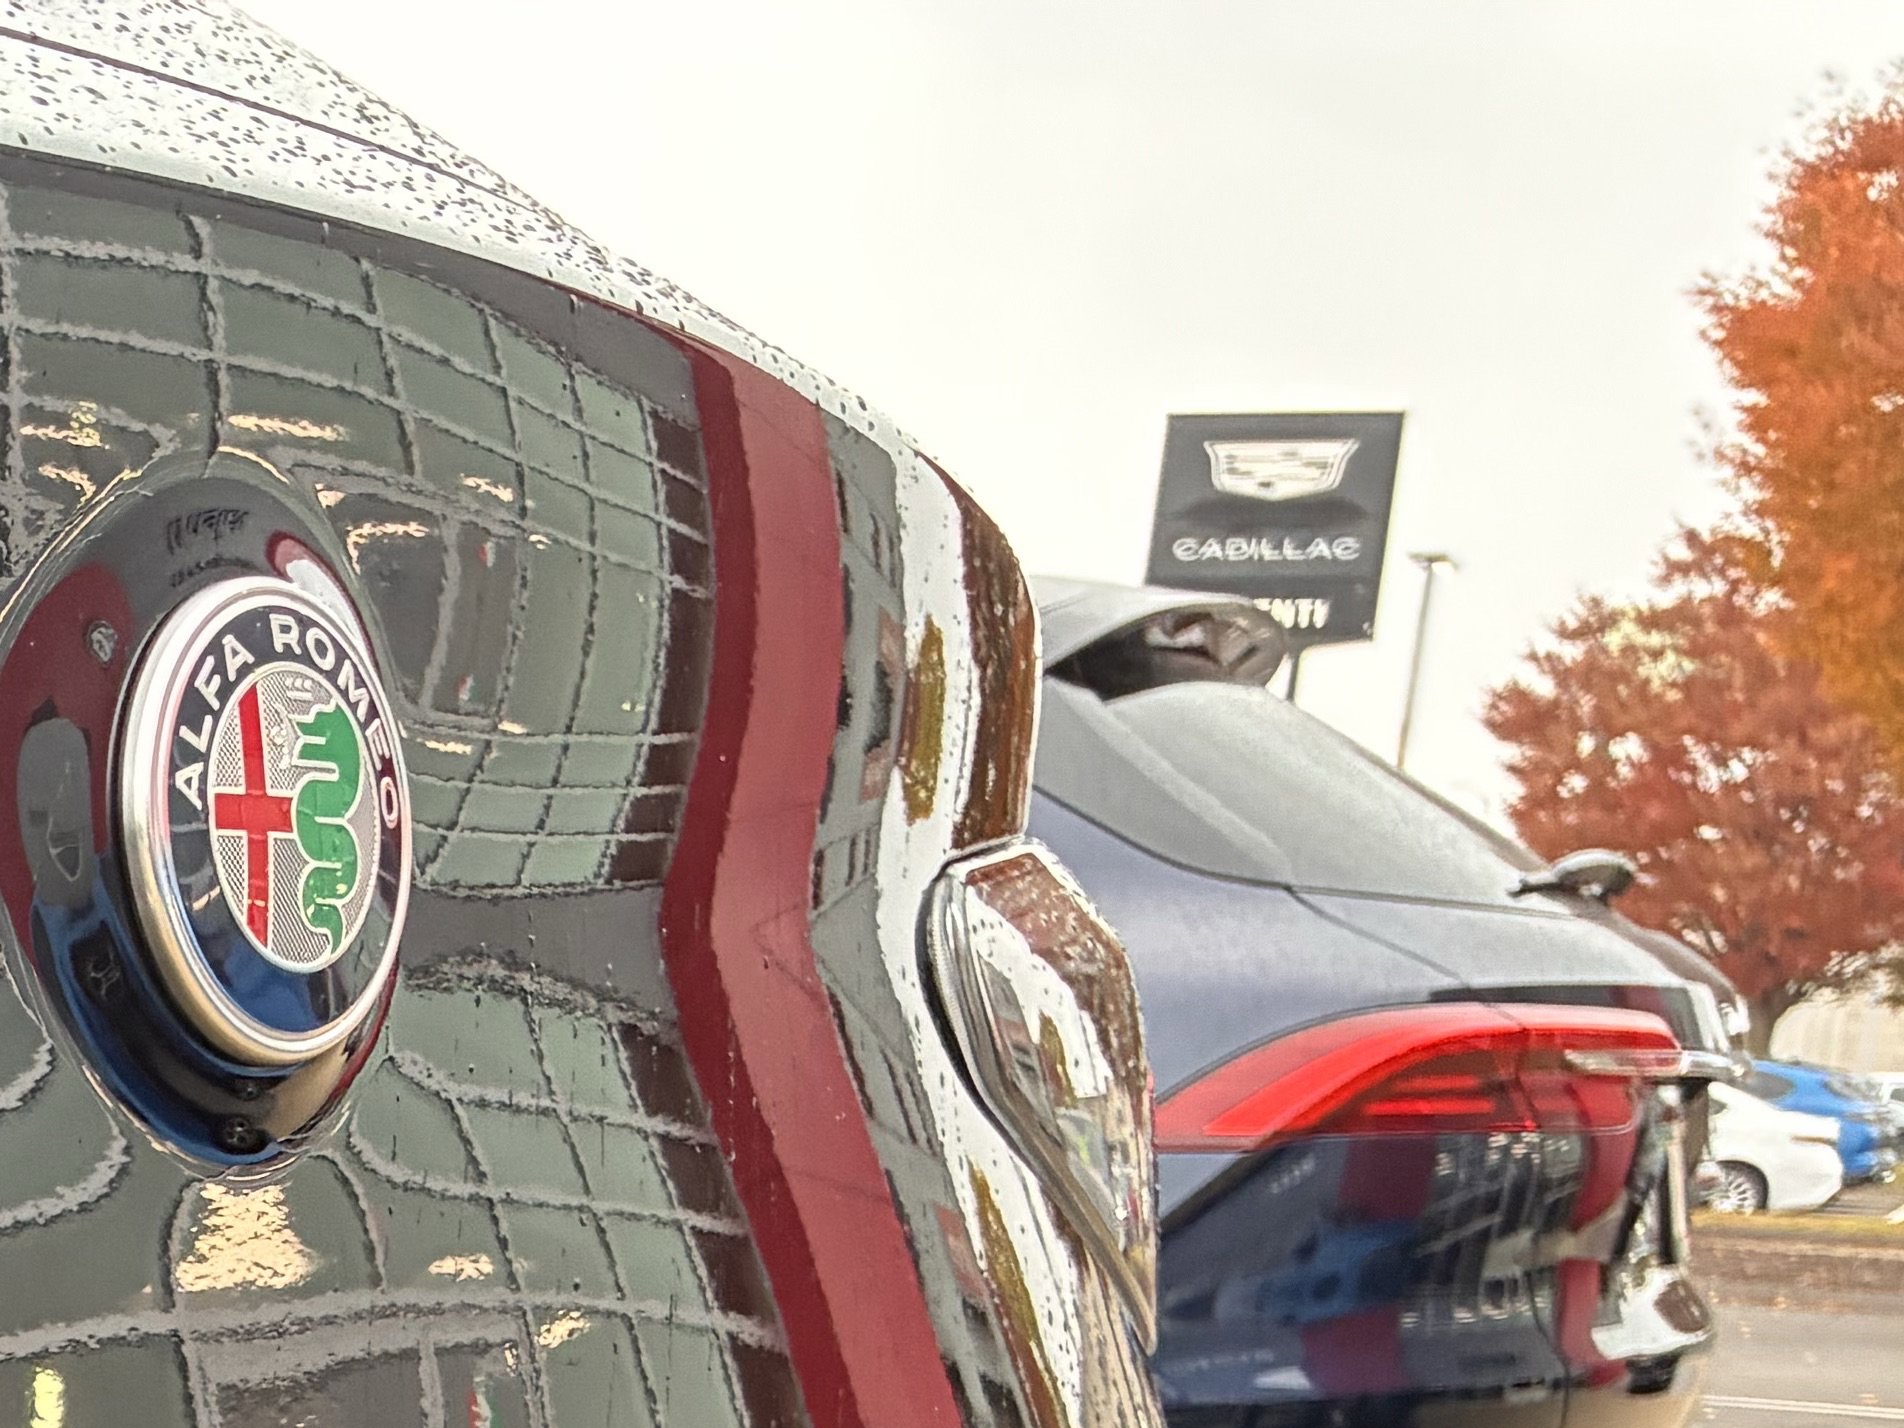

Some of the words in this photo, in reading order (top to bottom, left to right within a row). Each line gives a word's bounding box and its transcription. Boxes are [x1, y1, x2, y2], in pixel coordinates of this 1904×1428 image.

[1172, 536, 1361, 561] CADILLAC
[175, 633, 256, 810] ALFA
[272, 614, 399, 829] ROMEO
